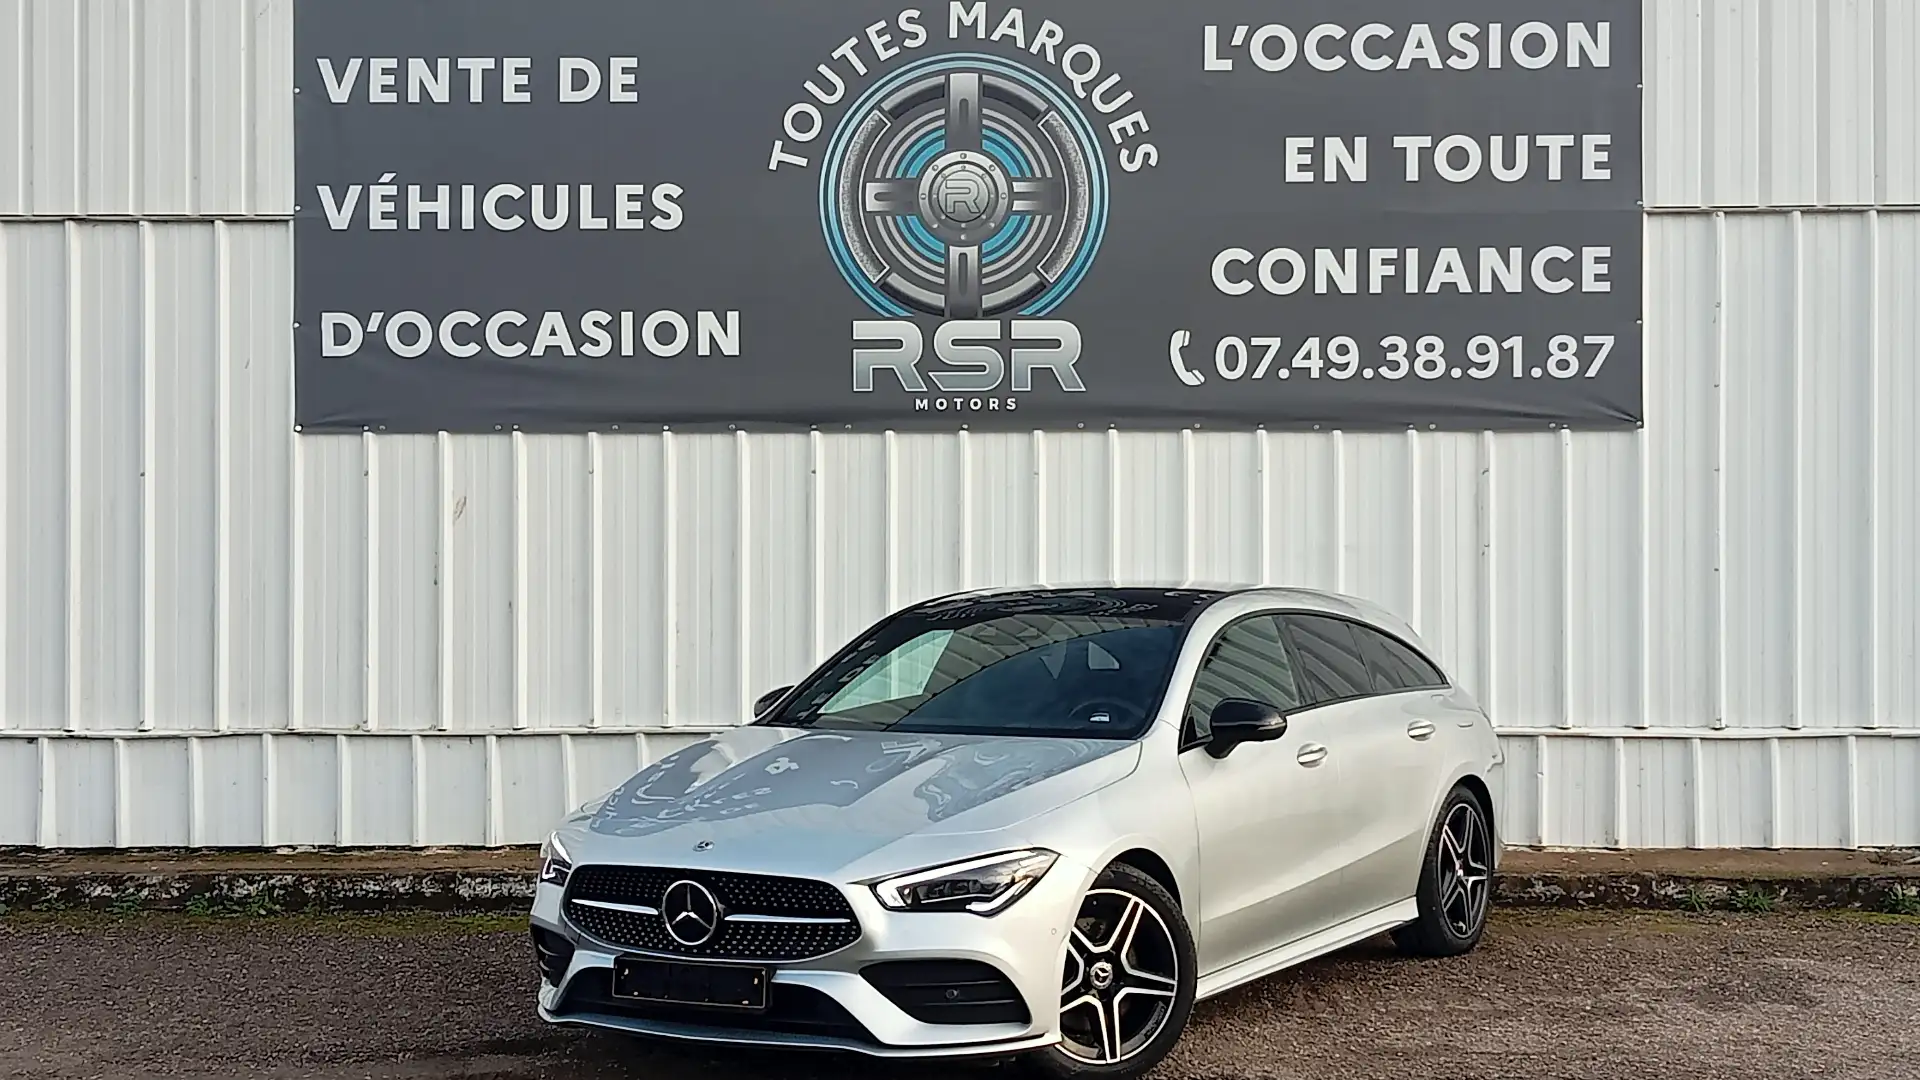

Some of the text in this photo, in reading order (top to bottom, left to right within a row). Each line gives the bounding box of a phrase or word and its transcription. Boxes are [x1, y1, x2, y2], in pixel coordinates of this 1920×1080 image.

[1203, 21, 1611, 72] L'OCCASION
[316, 57, 638, 103] VENTE DE
[768, 1, 1160, 173] TOUTES MARQUES
[1285, 134, 1612, 183] EN TOUTE
[316, 172, 684, 231] VÉHICULES
[944, 178, 981, 214] R
[1211, 246, 1612, 296] CONFIANCE
[321, 310, 741, 358] D'OCCASION
[852, 319, 1087, 392] RSR
[1214, 334, 1616, 380] 07.49.38.91.87
[915, 397, 1017, 411] MOTORS
